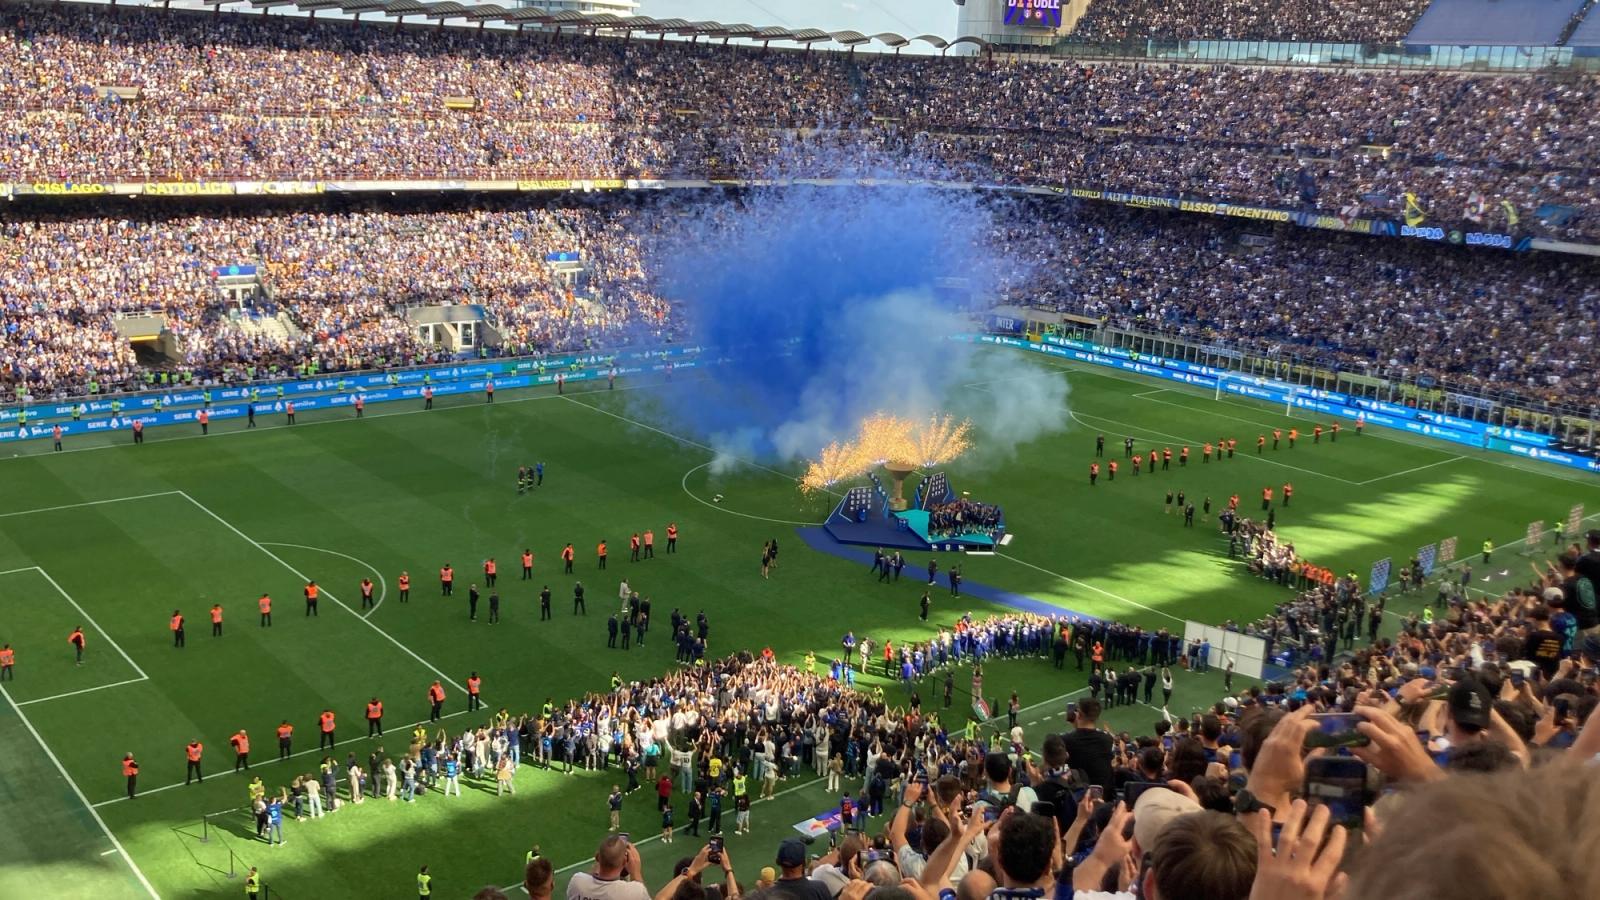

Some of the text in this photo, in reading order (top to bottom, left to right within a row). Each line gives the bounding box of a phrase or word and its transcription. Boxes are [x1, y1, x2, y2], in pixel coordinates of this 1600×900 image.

[33, 183, 105, 194] CISLAGO
[1131, 195, 1172, 208] POLESINE
[1180, 201, 1289, 221] BASSO VICENTINO
